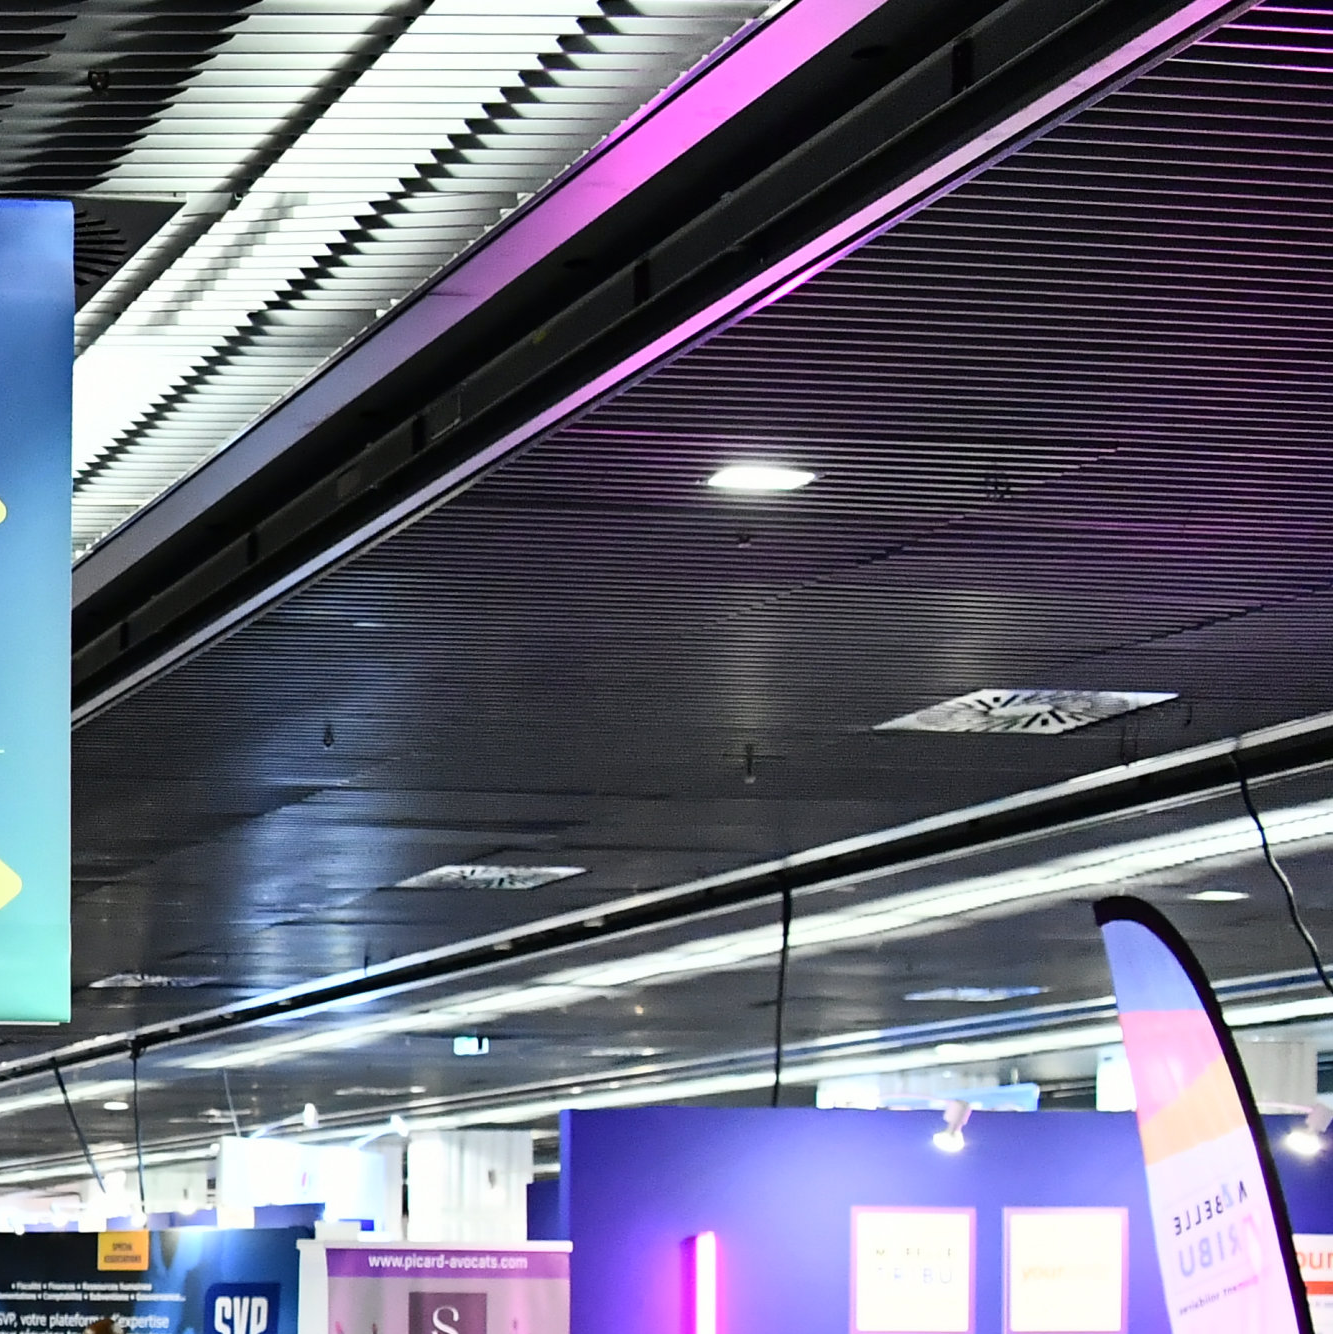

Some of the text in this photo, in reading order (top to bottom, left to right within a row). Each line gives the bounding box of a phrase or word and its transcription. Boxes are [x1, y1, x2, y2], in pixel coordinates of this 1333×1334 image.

[368, 1253, 528, 1270] www.picard-avocats.com
[20, 1314, 47, 1327] votre
[49, 1312, 104, 1328] plateform
